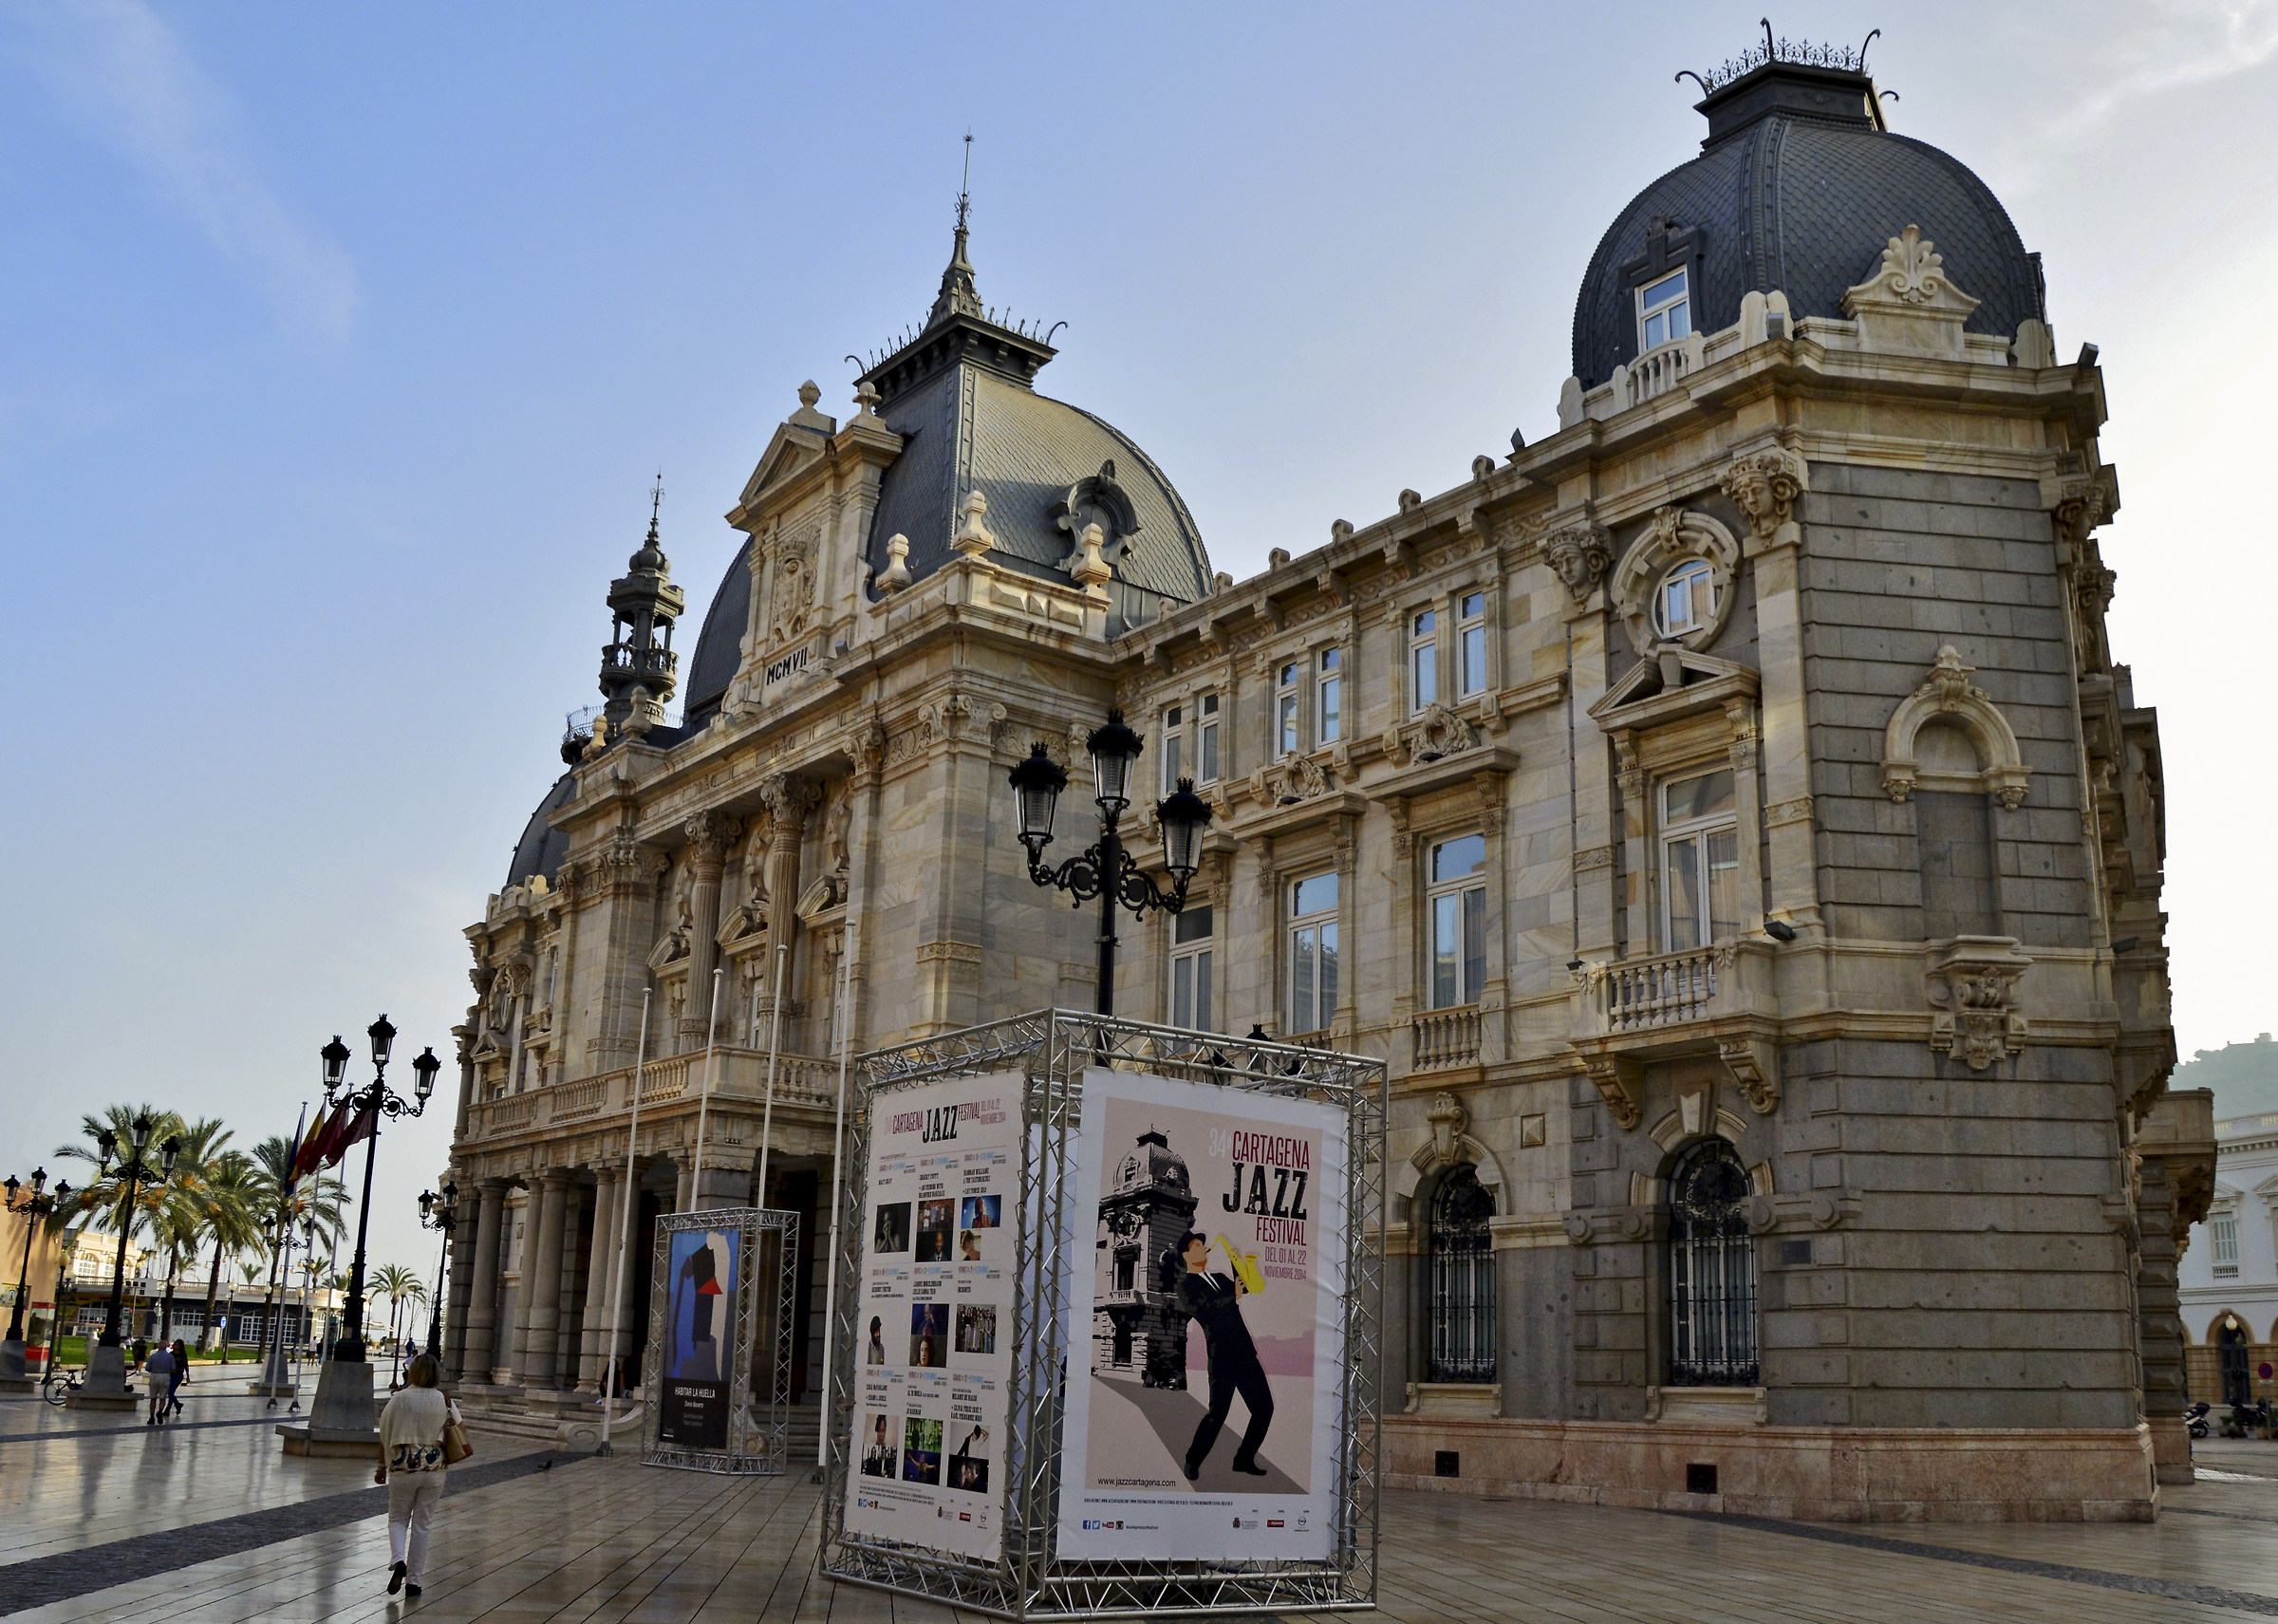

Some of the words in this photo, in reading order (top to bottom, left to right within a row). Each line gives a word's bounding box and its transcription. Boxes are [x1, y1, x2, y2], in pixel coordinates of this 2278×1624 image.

[766, 646, 808, 685] MCMVII
[893, 1111, 923, 1134] CARTAGENA
[923, 1105, 958, 1143] JAZZ
[958, 1101, 980, 1121] FESTIVAL
[1232, 1130, 1310, 1169] CARTAGENA
[1223, 1162, 1308, 1220] JAZZ
[1256, 1216, 1307, 1246] FESTIVAL
[1264, 1246, 1278, 1262] DEL
[1279, 1248, 1287, 1263] 01
[1288, 1249, 1297, 1264] AL
[1298, 1250, 1307, 1265] 22
[1264, 1265, 1294, 1279] NOVIEMBRE
[1294, 1268, 1307, 1280] 2014
[675, 1387, 692, 1396] HABITAR
[693, 1388, 698, 1397] LA
[699, 1389, 716, 1399] HUELLA
[1097, 1477, 1176, 1487] www.jazzcartagena.com
